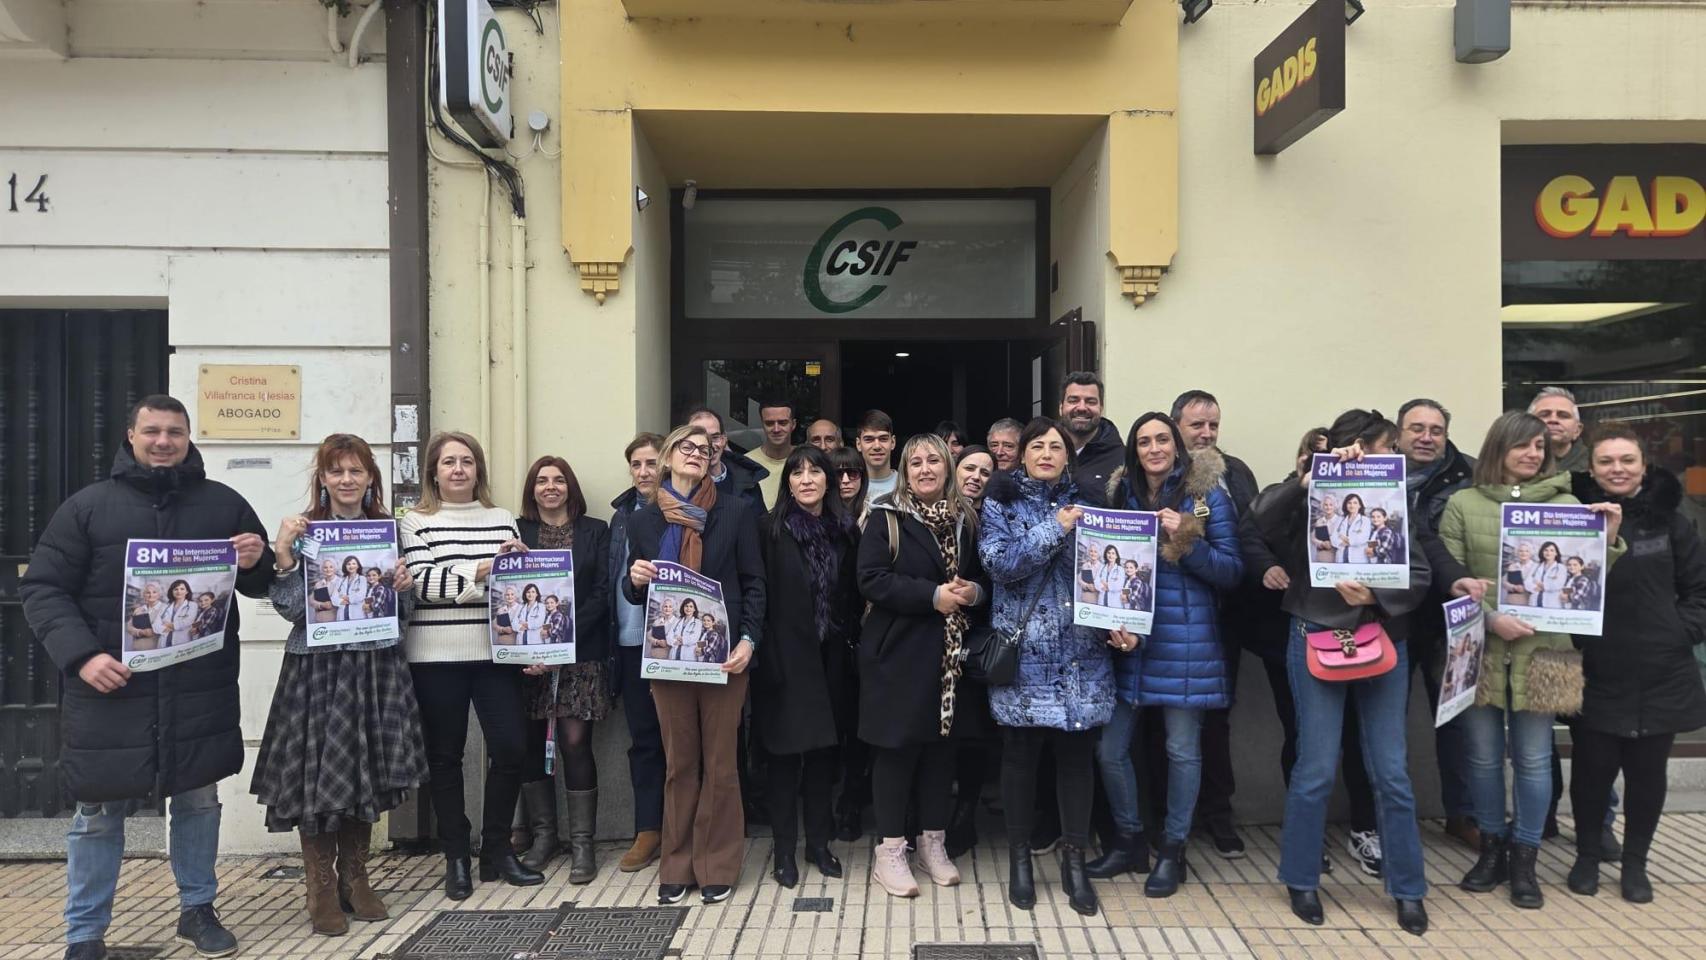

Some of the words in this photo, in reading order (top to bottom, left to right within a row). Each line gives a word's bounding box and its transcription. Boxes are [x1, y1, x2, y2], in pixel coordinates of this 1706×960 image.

[486, 44, 509, 92] CSIF
[1256, 37, 1317, 116] GADIS
[8, 172, 50, 213] 14
[1535, 174, 1706, 239] GAD
[826, 240, 918, 276] CSIF
[230, 376, 267, 385] Cristina
[204, 391, 256, 400] Villafranca
[217, 408, 281, 418] ABOGADO
[1318, 461, 1342, 477] 8M
[1083, 512, 1103, 528] 8M
[1115, 517, 1149, 525] Internacional
[1511, 510, 1540, 525] 8M
[313, 527, 340, 541] 8M
[136, 547, 168, 563] 8M
[184, 547, 228, 556] Internacional
[193, 554, 219, 562] Mujeres
[499, 557, 522, 570] 8M
[658, 568, 682, 582] 8M
[1450, 605, 1466, 624] 8M
